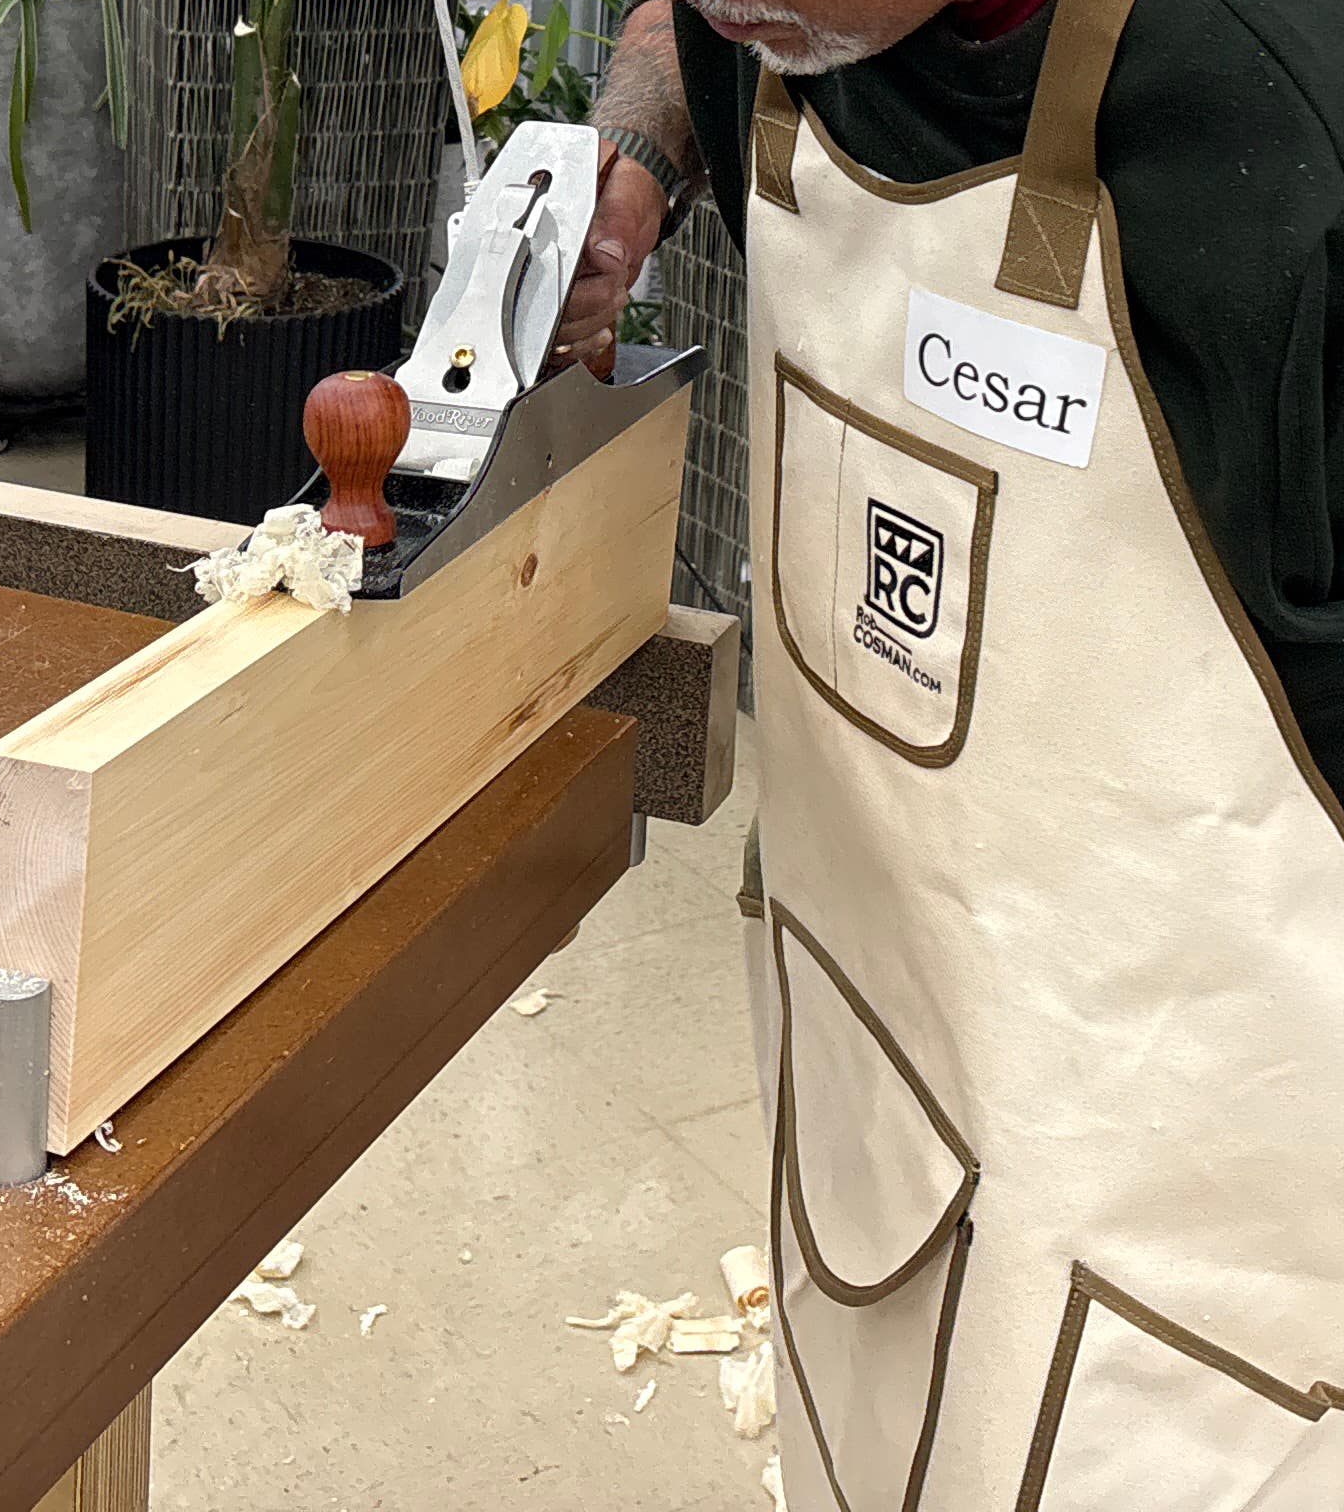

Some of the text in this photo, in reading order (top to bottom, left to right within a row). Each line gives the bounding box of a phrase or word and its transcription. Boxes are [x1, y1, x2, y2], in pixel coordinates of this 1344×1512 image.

[918, 332, 1088, 434] Cesar
[874, 553, 931, 625] RC
[853, 624, 942, 695] COSMAN.COM
